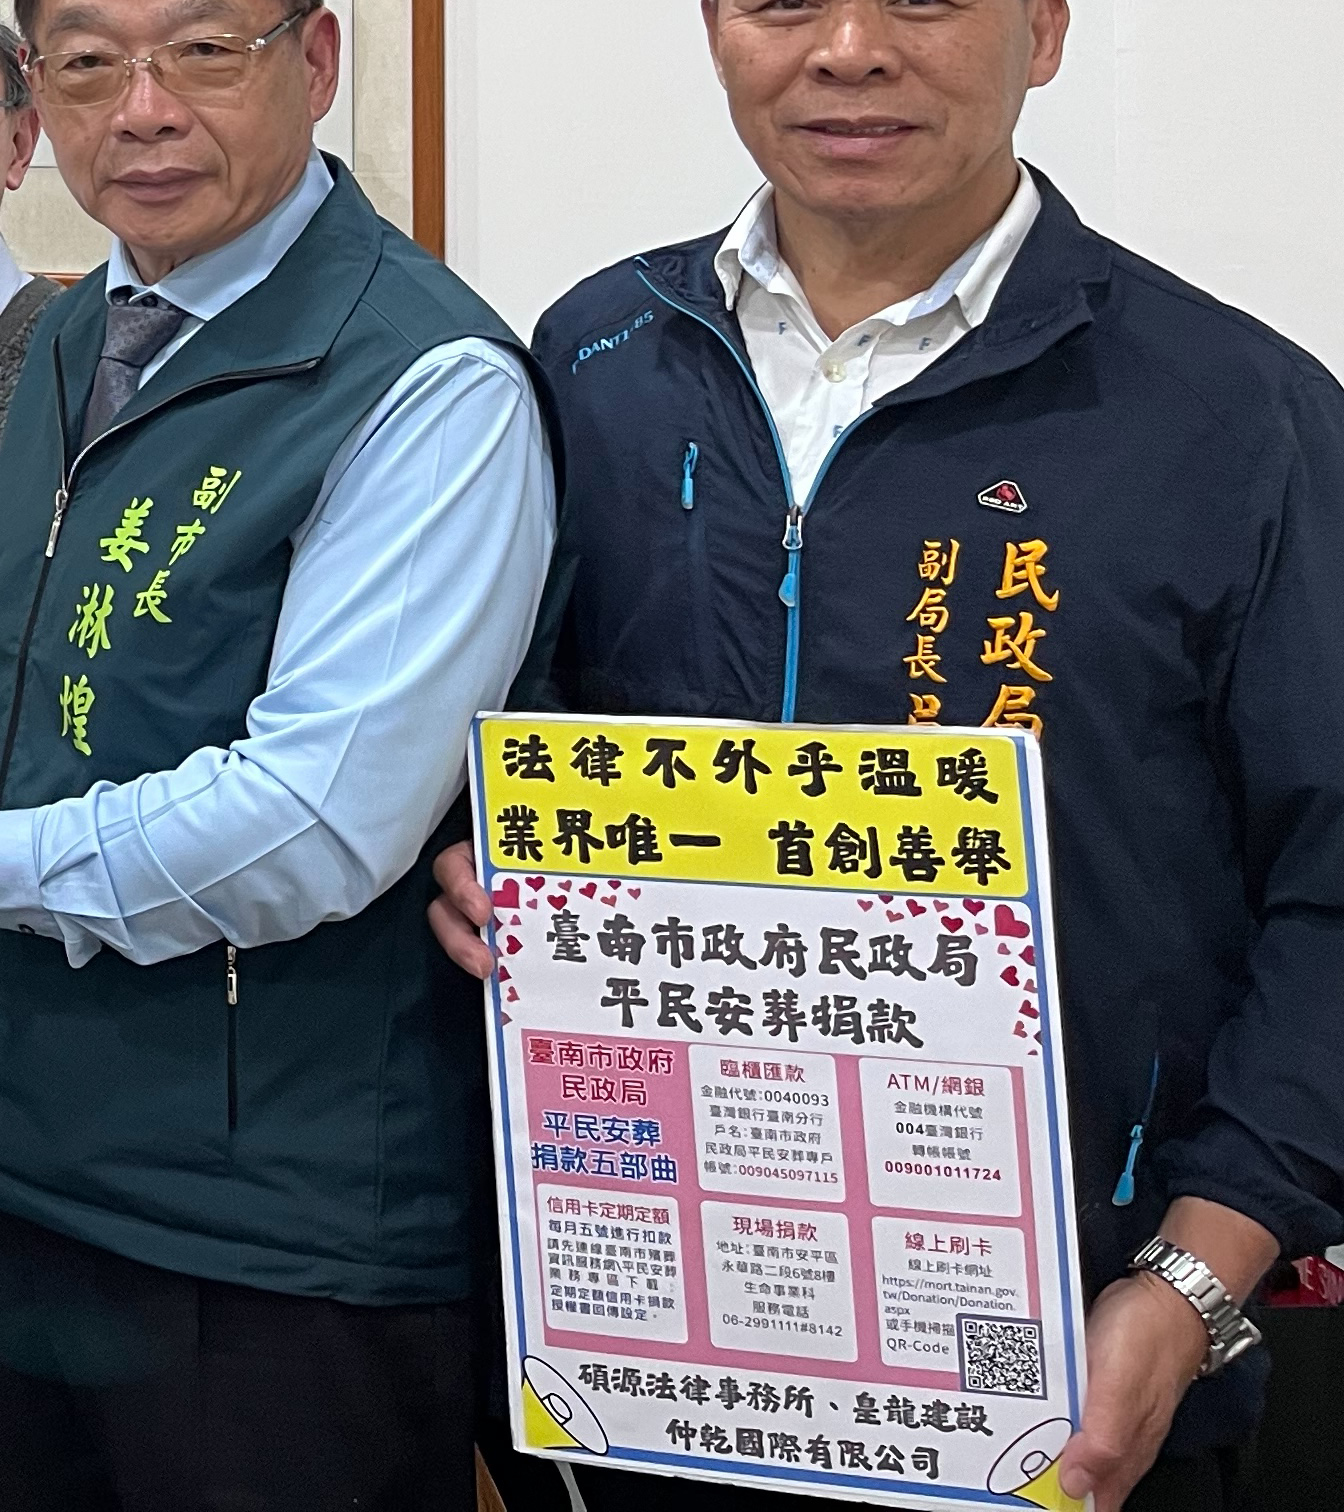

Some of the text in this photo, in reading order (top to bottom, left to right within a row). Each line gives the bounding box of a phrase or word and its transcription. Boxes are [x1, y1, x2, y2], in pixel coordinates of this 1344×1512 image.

[133, 466, 242, 623] 副市長
[502, 735, 1000, 805] 法律不外乎溫暖
[496, 805, 1011, 886] 業界唯一 首創善舉
[546, 908, 980, 987] 臺南市政府民政局
[600, 977, 925, 1049] 平民安葬捐款
[529, 1038, 674, 1075] 臺南市政府
[720, 1059, 806, 1083] 臨櫃匯款
[562, 1074, 648, 1106] 民政局
[887, 1073, 986, 1097] ATM/網銀
[543, 1111, 662, 1147] 平民安葬
[531, 1143, 678, 1183] 捐款五部曲
[885, 1160, 1002, 1181] 009001011724
[547, 1196, 670, 1225] 信用卡定期定額
[732, 1216, 818, 1242] 現場捐款
[904, 1231, 993, 1257] 線上刷卡
[886, 1338, 950, 1355] QR-Code
[665, 1418, 940, 1481] 仲乾國際有限公司
